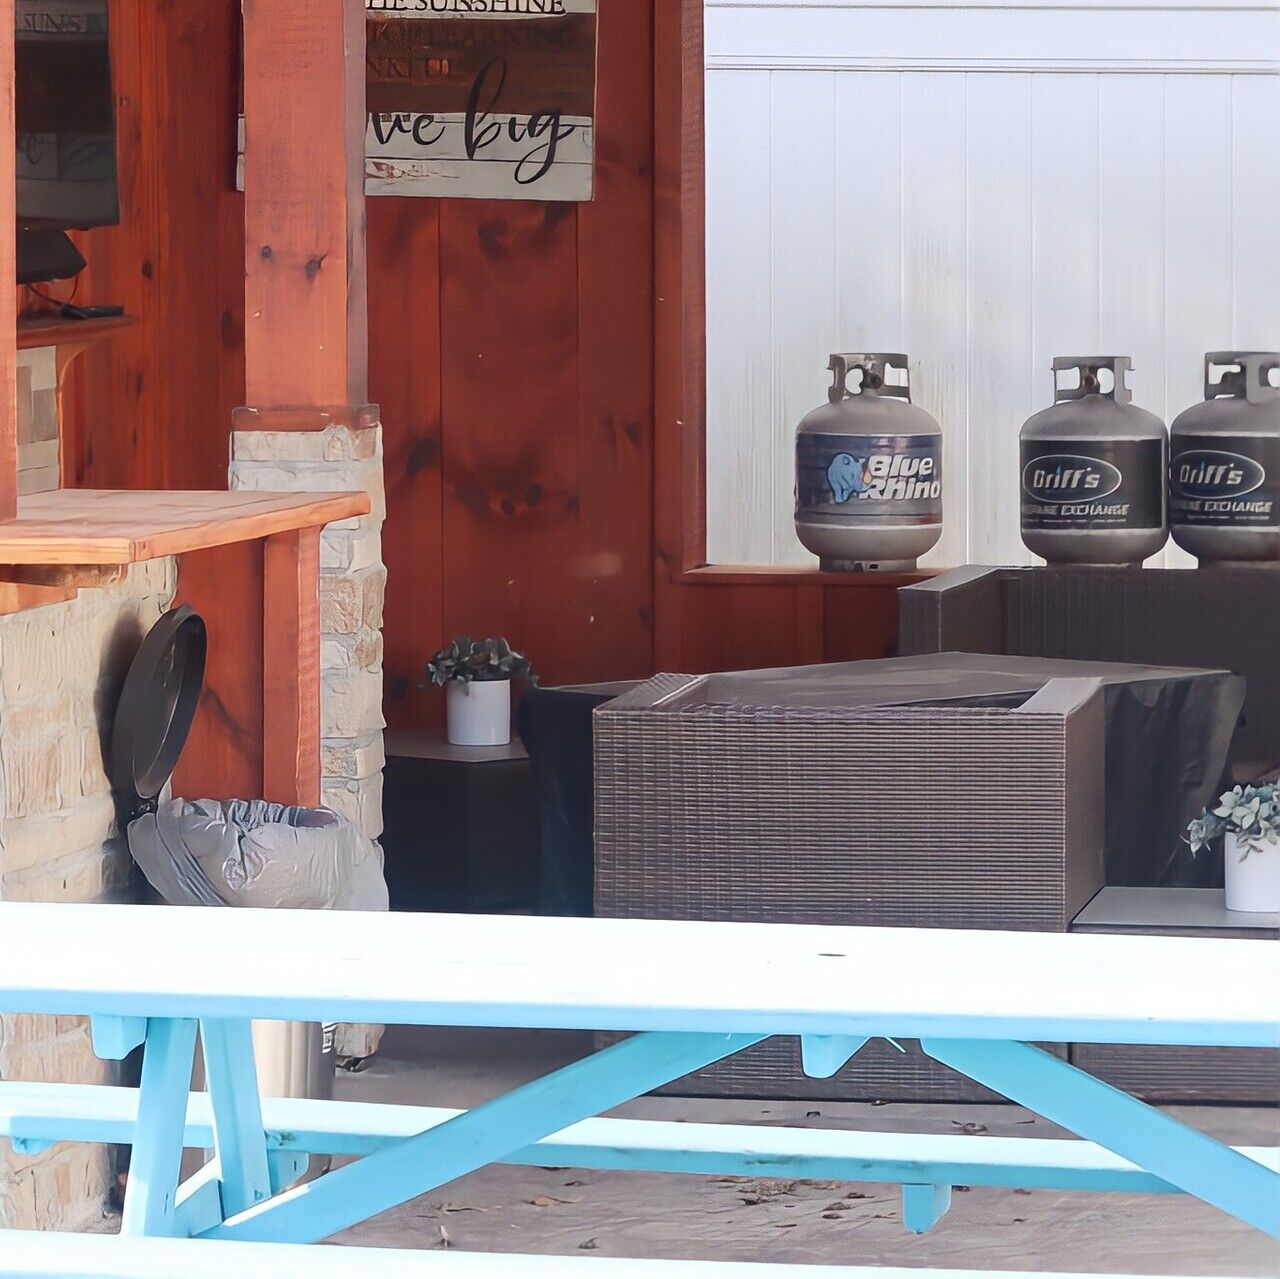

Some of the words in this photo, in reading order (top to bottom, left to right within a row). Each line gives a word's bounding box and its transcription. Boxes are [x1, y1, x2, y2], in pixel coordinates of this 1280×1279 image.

[370, 111, 446, 146] ve
[464, 57, 576, 185] big
[868, 454, 934, 477] Blue
[859, 477, 940, 500] Rhino
